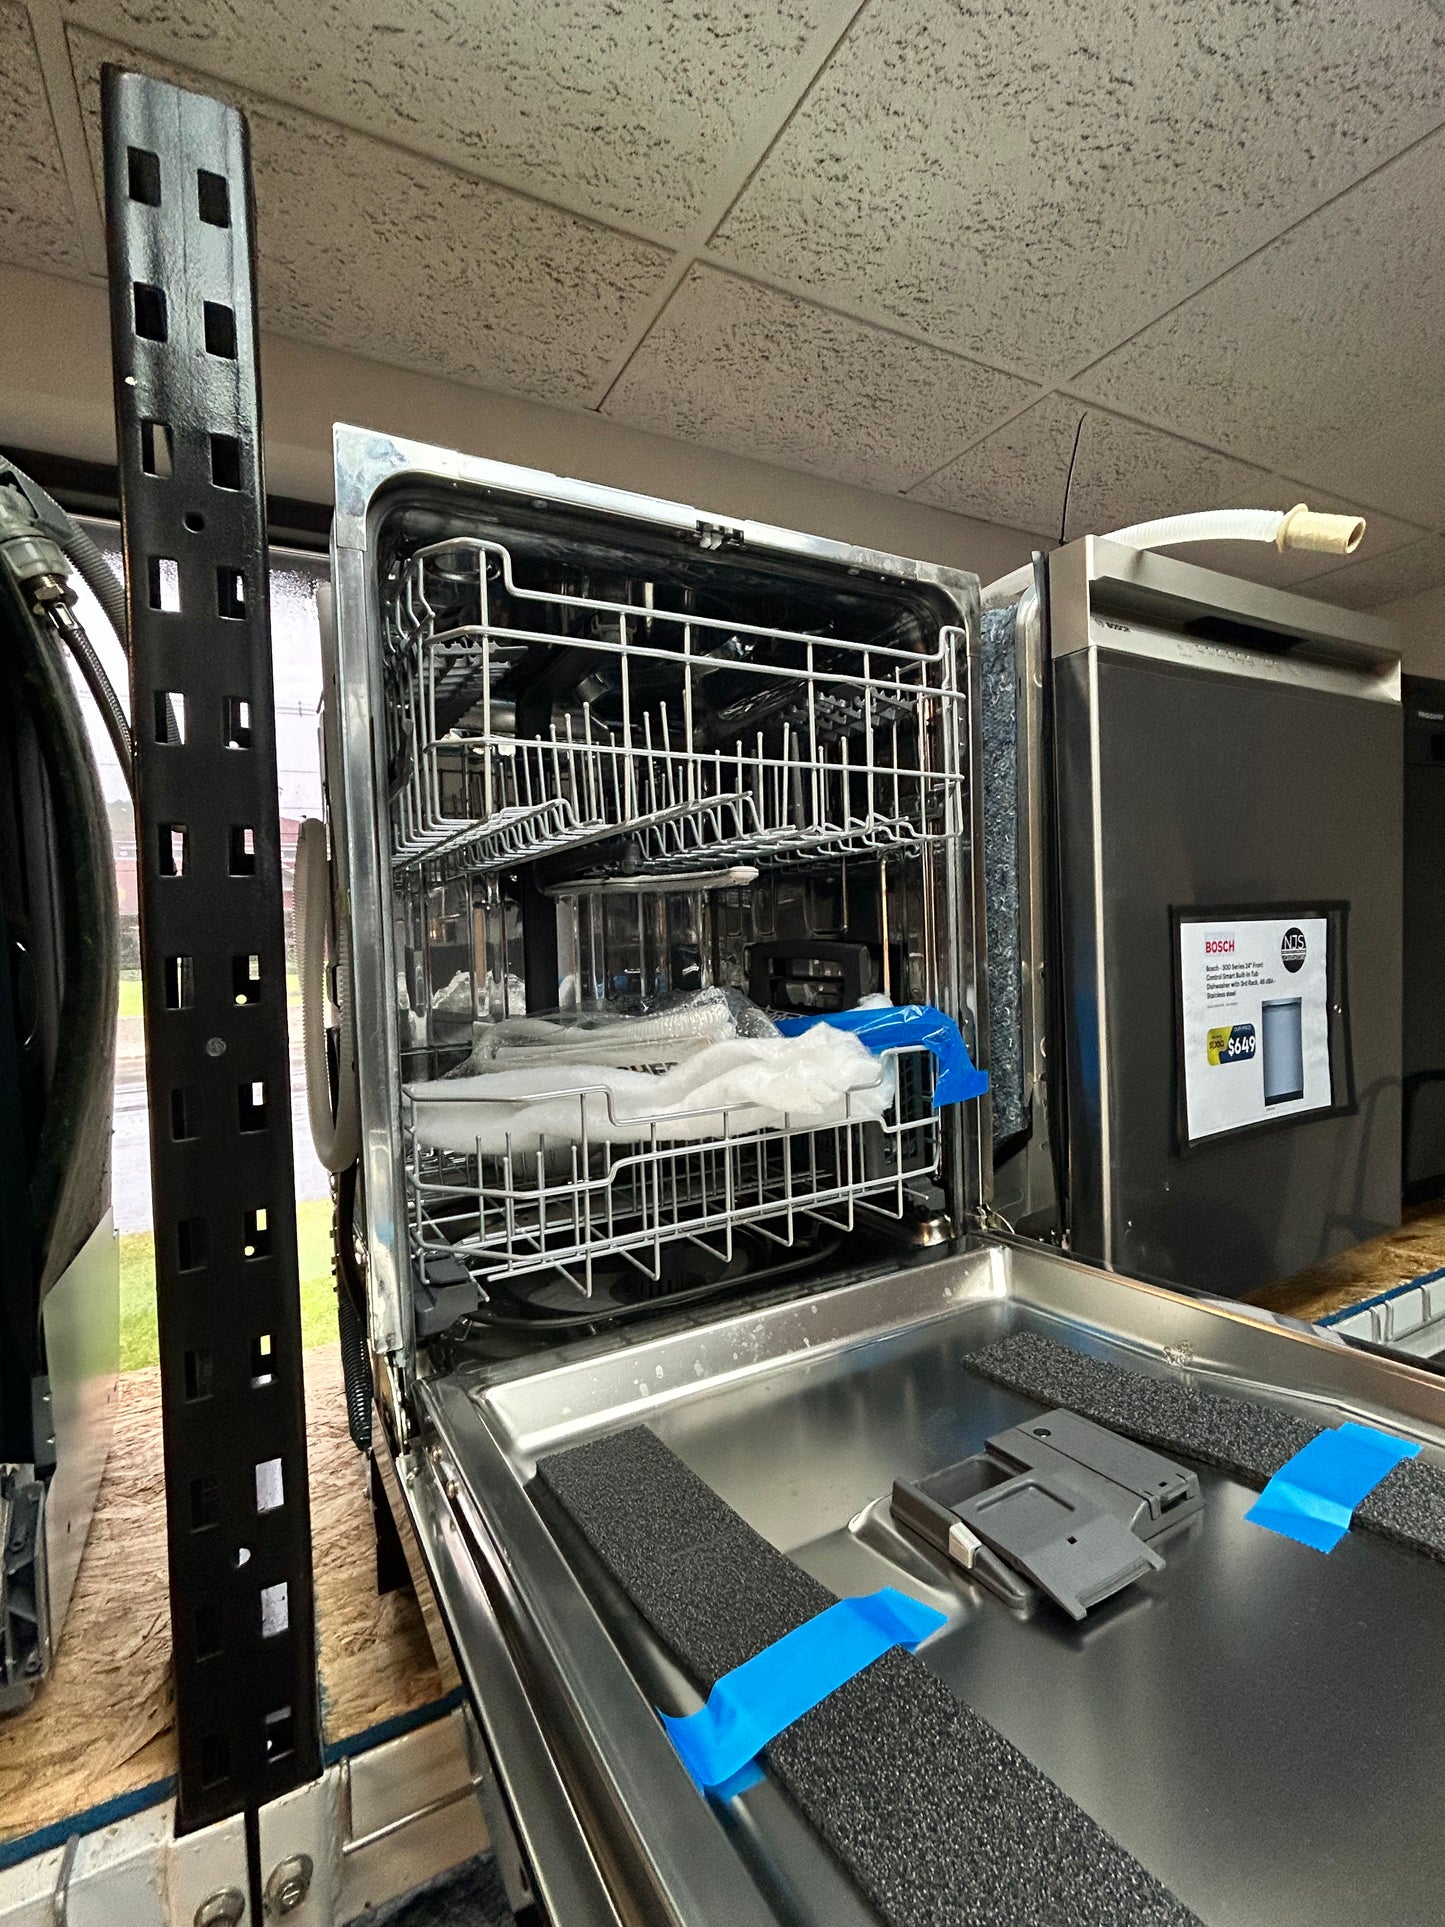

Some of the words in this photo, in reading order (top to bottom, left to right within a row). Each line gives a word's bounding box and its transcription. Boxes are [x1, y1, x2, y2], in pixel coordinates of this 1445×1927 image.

[1205, 940, 1235, 954] BOSCH
[1206, 964, 1219, 972] Bosch
[1231, 962, 1245, 970] Series
[1252, 961, 1264, 969] Front
[1206, 973, 1222, 981] Control
[1222, 972, 1236, 980] Smart
[1206, 991, 1226, 1000] Stainless
[1228, 1035, 1256, 1056] $649
